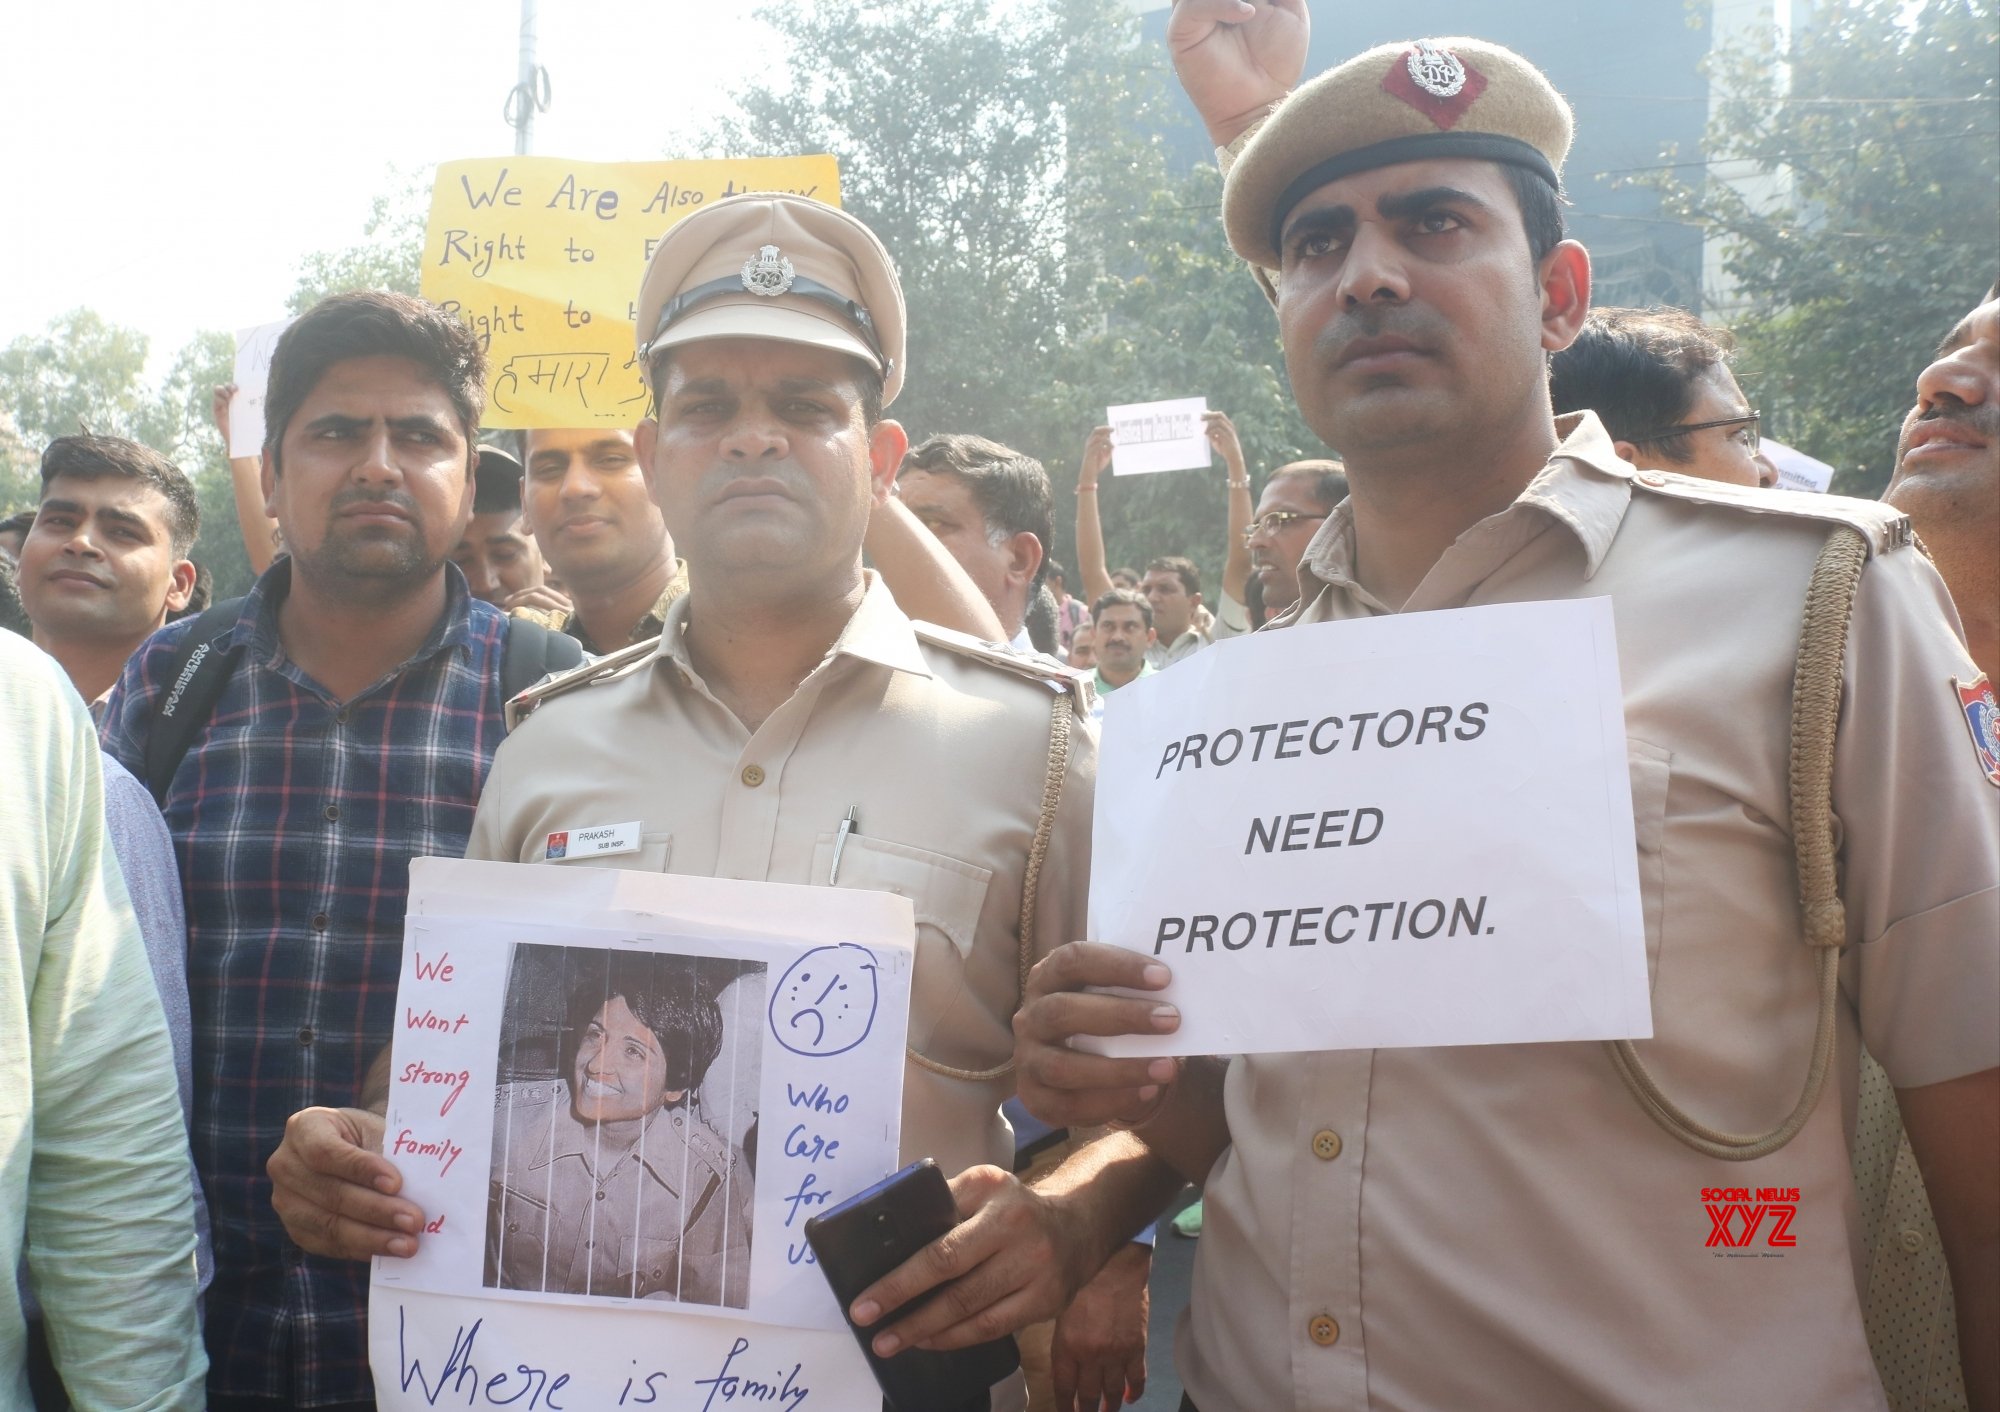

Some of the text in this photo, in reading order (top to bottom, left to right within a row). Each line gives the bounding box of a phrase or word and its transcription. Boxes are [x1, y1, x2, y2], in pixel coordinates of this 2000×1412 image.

[461, 168, 522, 210] We
[545, 173, 619, 220] Are
[642, 180, 704, 214] Also
[439, 229, 595, 278] Right to
[563, 300, 592, 328] to
[162, 644, 205, 716] TOURISTER
[167, 643, 210, 717] AMERICAN
[1155, 702, 1489, 780] PROTECTORS
[578, 829, 615, 842] PRAKASH
[598, 840, 626, 850] SUB INSP.
[1244, 807, 1384, 855] NEED
[1153, 896, 1496, 955] PROTECTION.
[416, 952, 454, 982] We
[407, 1007, 469, 1034] Want
[787, 1083, 849, 1114] Who
[784, 1124, 840, 1163] Care
[784, 1173, 832, 1227] for
[400, 1305, 571, 1411] Where
[618, 1360, 668, 1407] is
